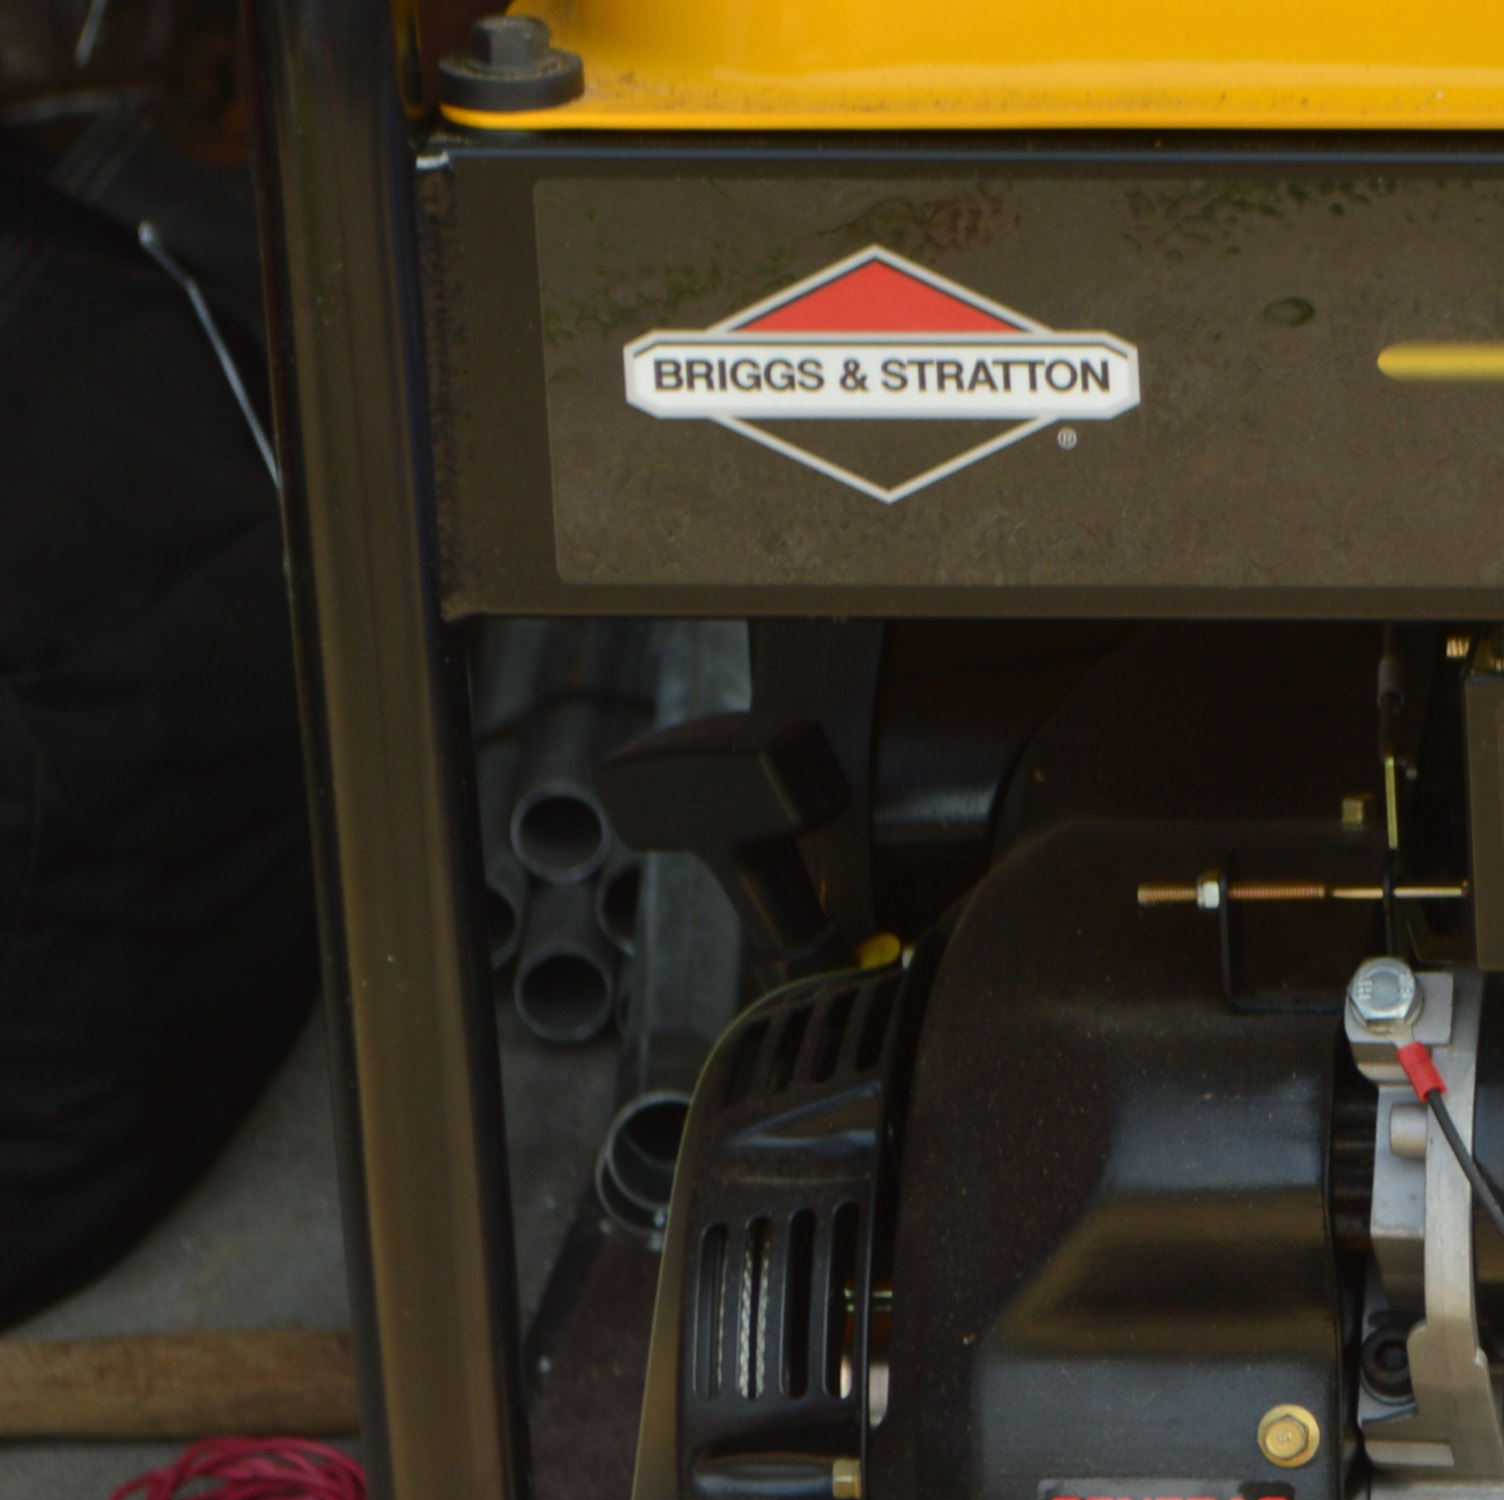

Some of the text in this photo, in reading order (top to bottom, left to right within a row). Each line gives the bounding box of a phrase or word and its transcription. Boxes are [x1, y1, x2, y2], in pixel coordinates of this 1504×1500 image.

[653, 358, 1110, 393] BRIGGS & STRATTON
